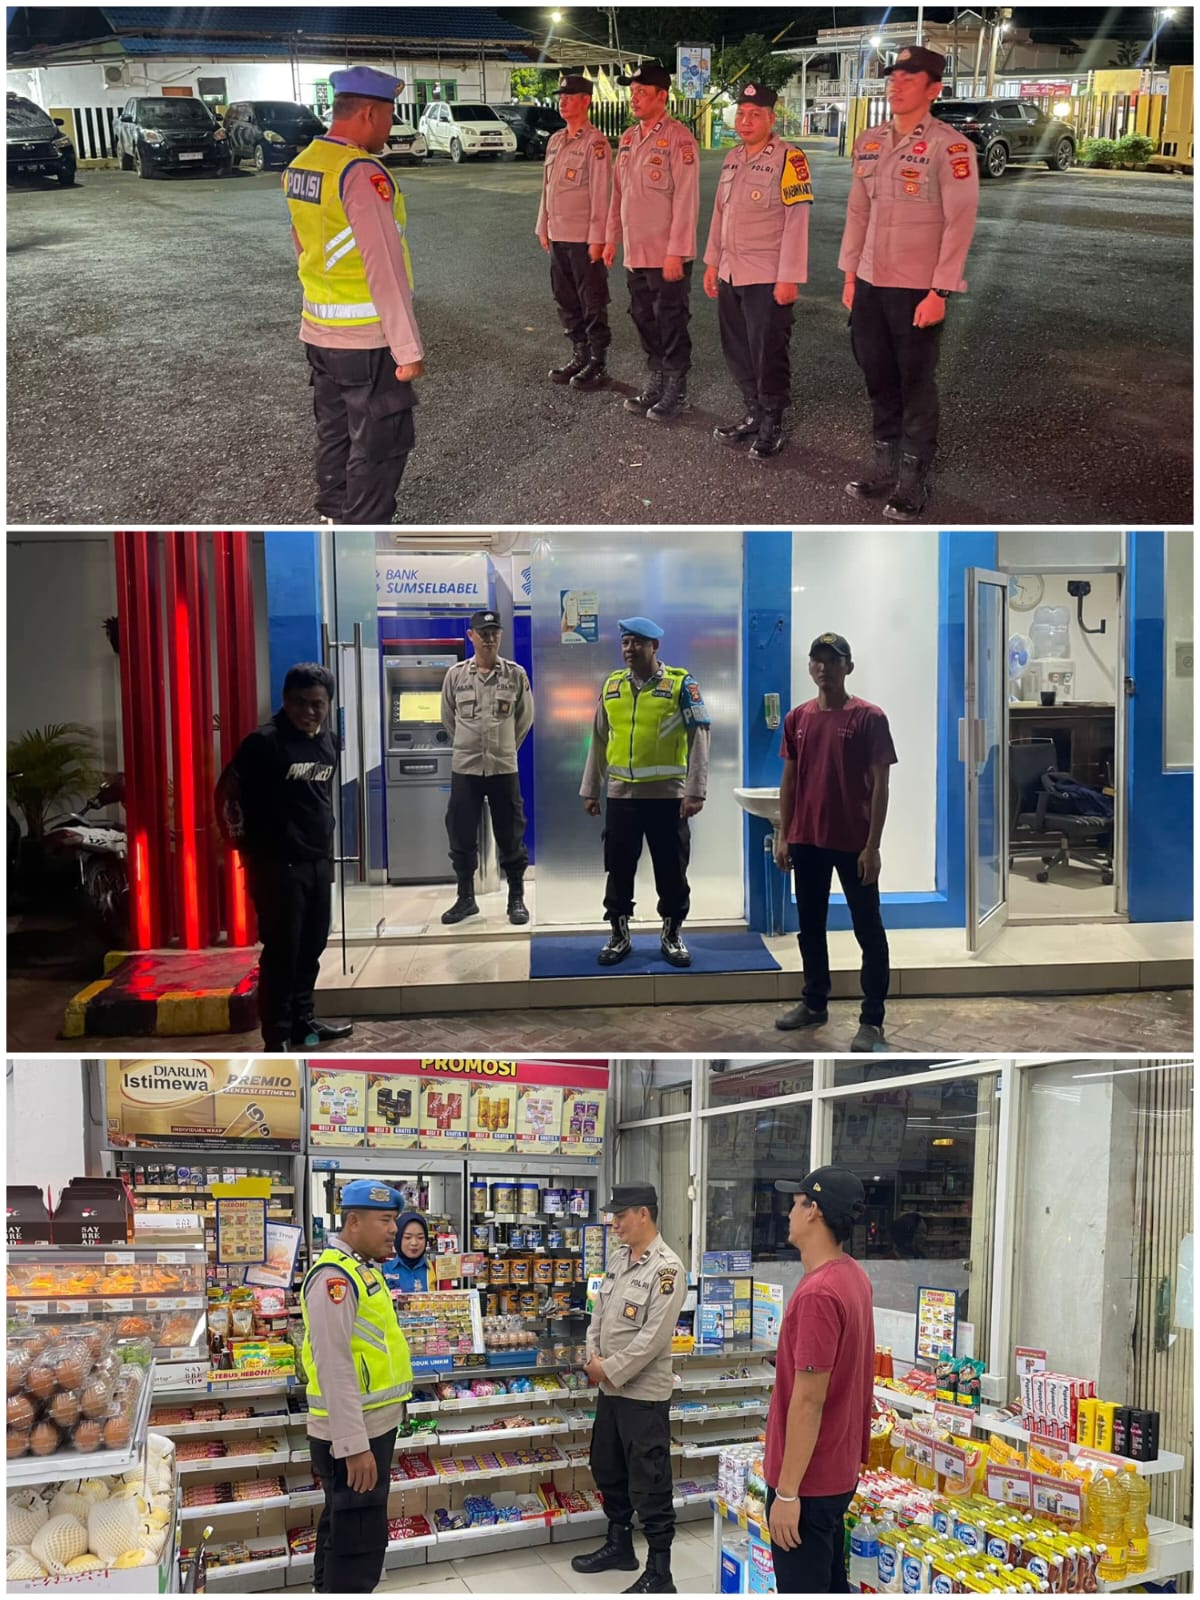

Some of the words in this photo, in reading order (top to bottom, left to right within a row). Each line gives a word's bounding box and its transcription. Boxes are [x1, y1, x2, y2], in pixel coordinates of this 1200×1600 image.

[900, 154, 930, 165] POLRI
[751, 164, 774, 174] POLRI
[287, 172, 321, 199] POLISI
[386, 569, 419, 580] BANK
[386, 582, 479, 594] SUMSELBABEL
[153, 1065, 207, 1078] DJARUM
[420, 1059, 517, 1077] PROMOSI
[124, 1073, 209, 1092] Istimewa
[227, 1074, 292, 1087] PREMIO
[258, 1089, 296, 1097] ISTIMEWA
[630, 1279, 650, 1290] POLRI
[214, 1371, 238, 1380] TEBUS
[241, 1369, 272, 1378] HEBOH!
